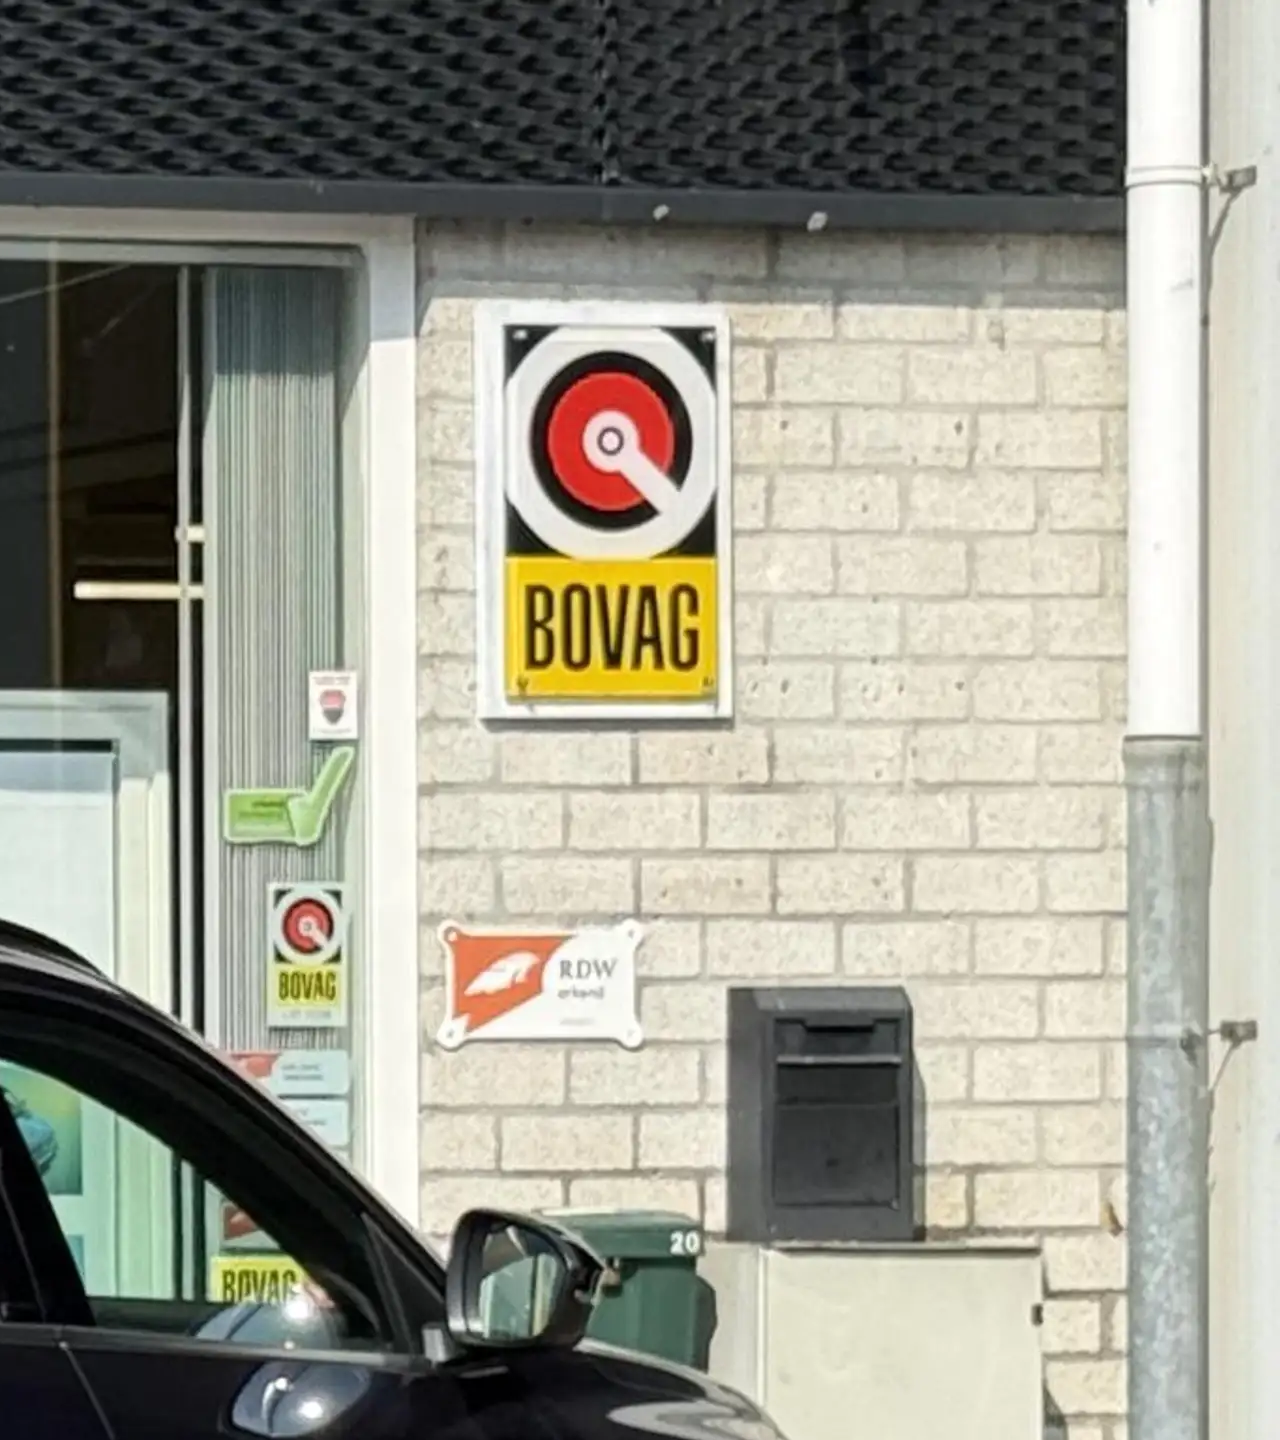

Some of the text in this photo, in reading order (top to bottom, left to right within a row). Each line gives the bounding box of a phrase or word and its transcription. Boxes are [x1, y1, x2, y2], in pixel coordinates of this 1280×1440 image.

[524, 582, 700, 672] BOVAG
[559, 957, 619, 980] RDW
[278, 971, 338, 1001] BOVAG
[670, 1229, 701, 1256] 20
